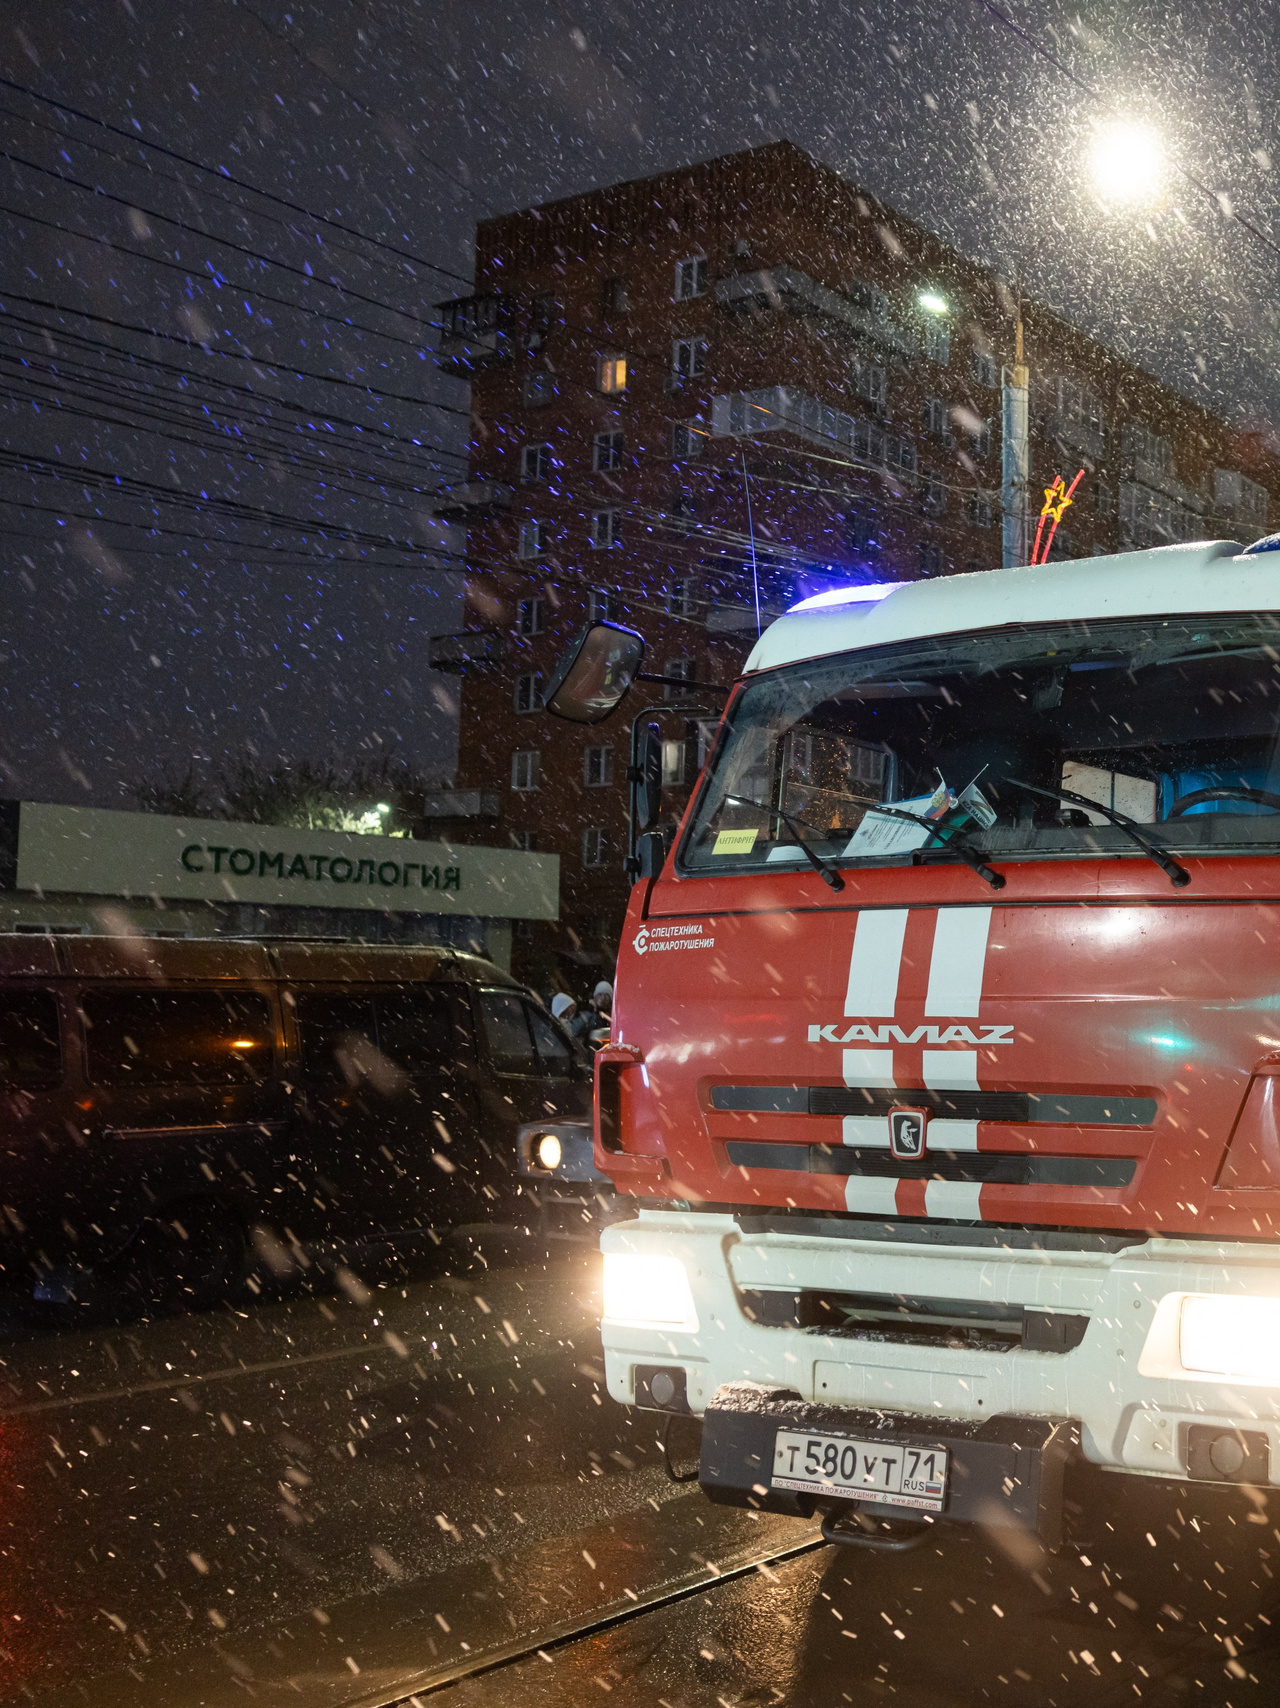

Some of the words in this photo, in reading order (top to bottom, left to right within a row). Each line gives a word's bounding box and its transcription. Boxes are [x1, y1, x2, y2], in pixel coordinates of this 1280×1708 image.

[717, 835, 756, 845] АНТИФРИЗ
[181, 844, 461, 891] СТОМАТОЛОГИЯ
[650, 924, 703, 938] СПЕЦТЕХНИКА
[648, 938, 715, 952] ПОЖАРОТУШЕНИЯ
[807, 1024, 1015, 1044] KAMAZ
[907, 1450, 937, 1481] 71
[774, 1479, 784, 1487] ПО
[903, 1478, 926, 1492] RUS
